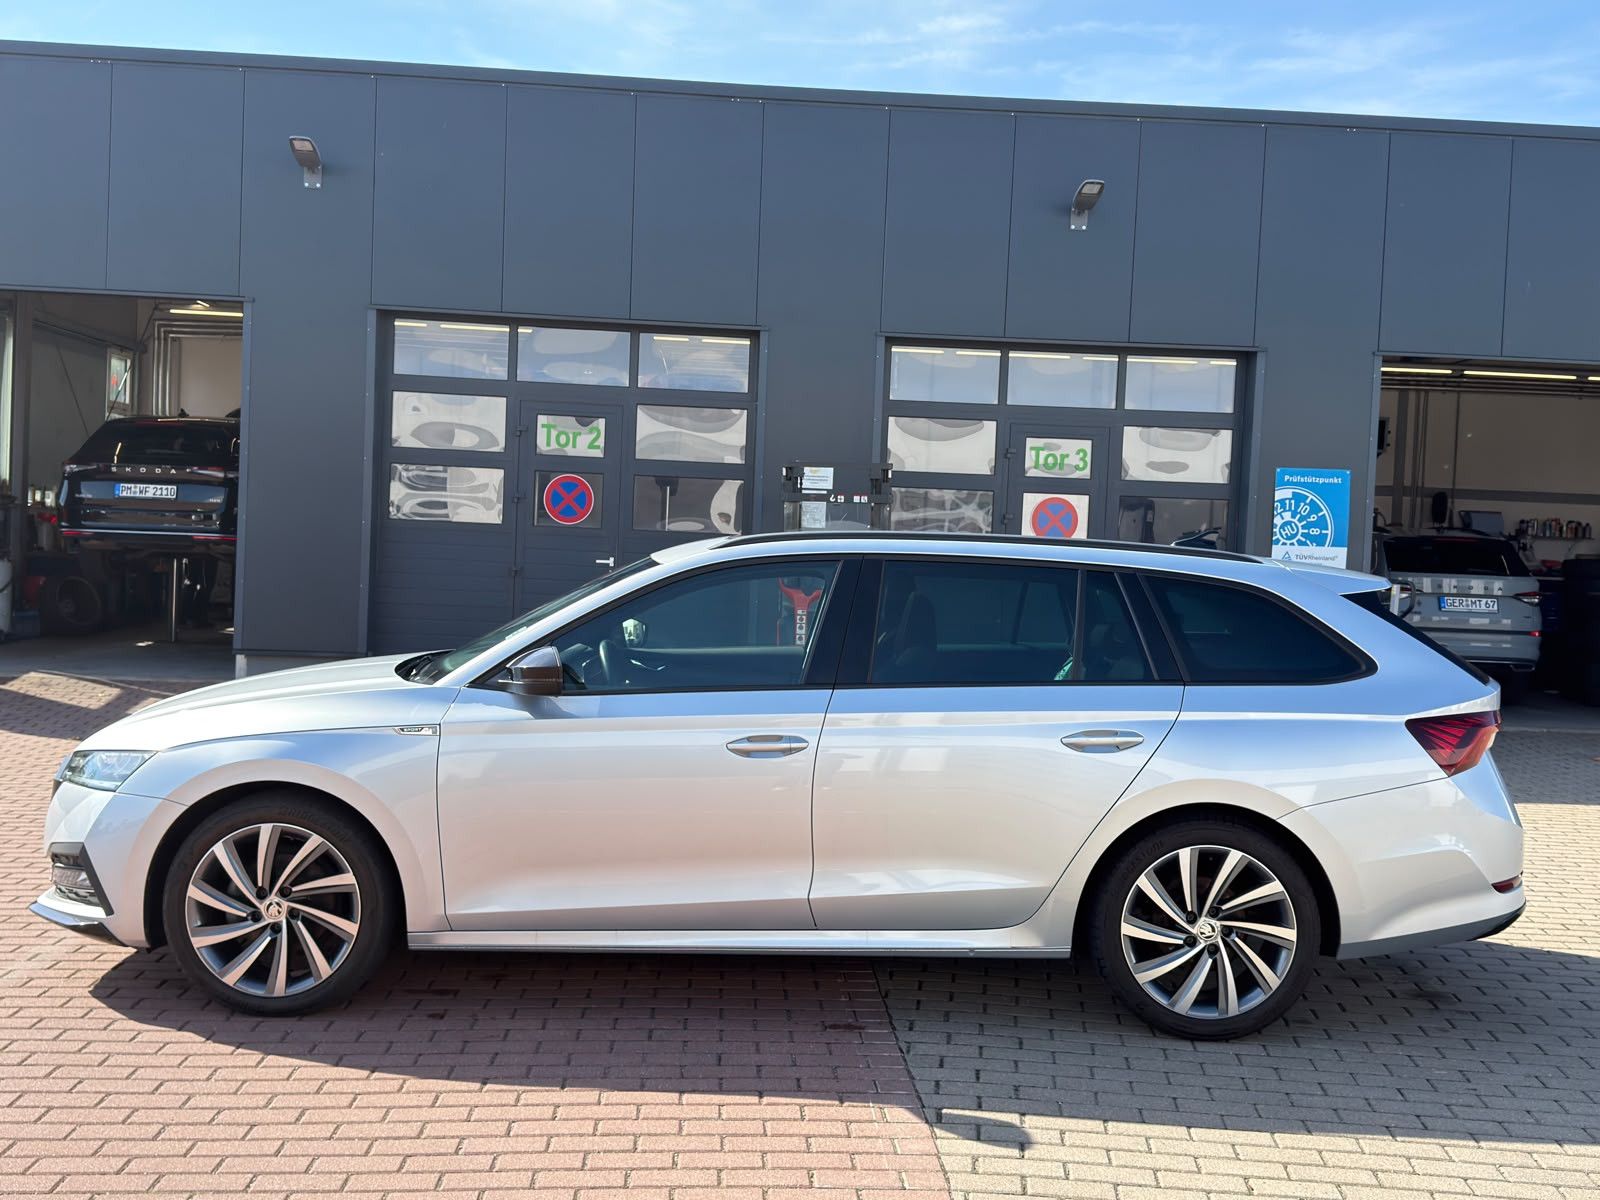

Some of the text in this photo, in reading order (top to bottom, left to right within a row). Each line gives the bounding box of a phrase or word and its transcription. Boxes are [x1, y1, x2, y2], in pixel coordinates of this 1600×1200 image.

[541, 424, 602, 450] Tor 2
[1030, 447, 1088, 472] Tor 3
[1284, 475, 1342, 484] Prüfstützpunkt
[120, 485, 176, 497] PM WF 2110
[1274, 502, 1284, 515] 2
[1285, 499, 1295, 511] 11
[1297, 502, 1310, 516] 10
[1307, 514, 1318, 522] 9
[1280, 523, 1297, 538] HU
[1446, 599, 1496, 609] GER MT 67
